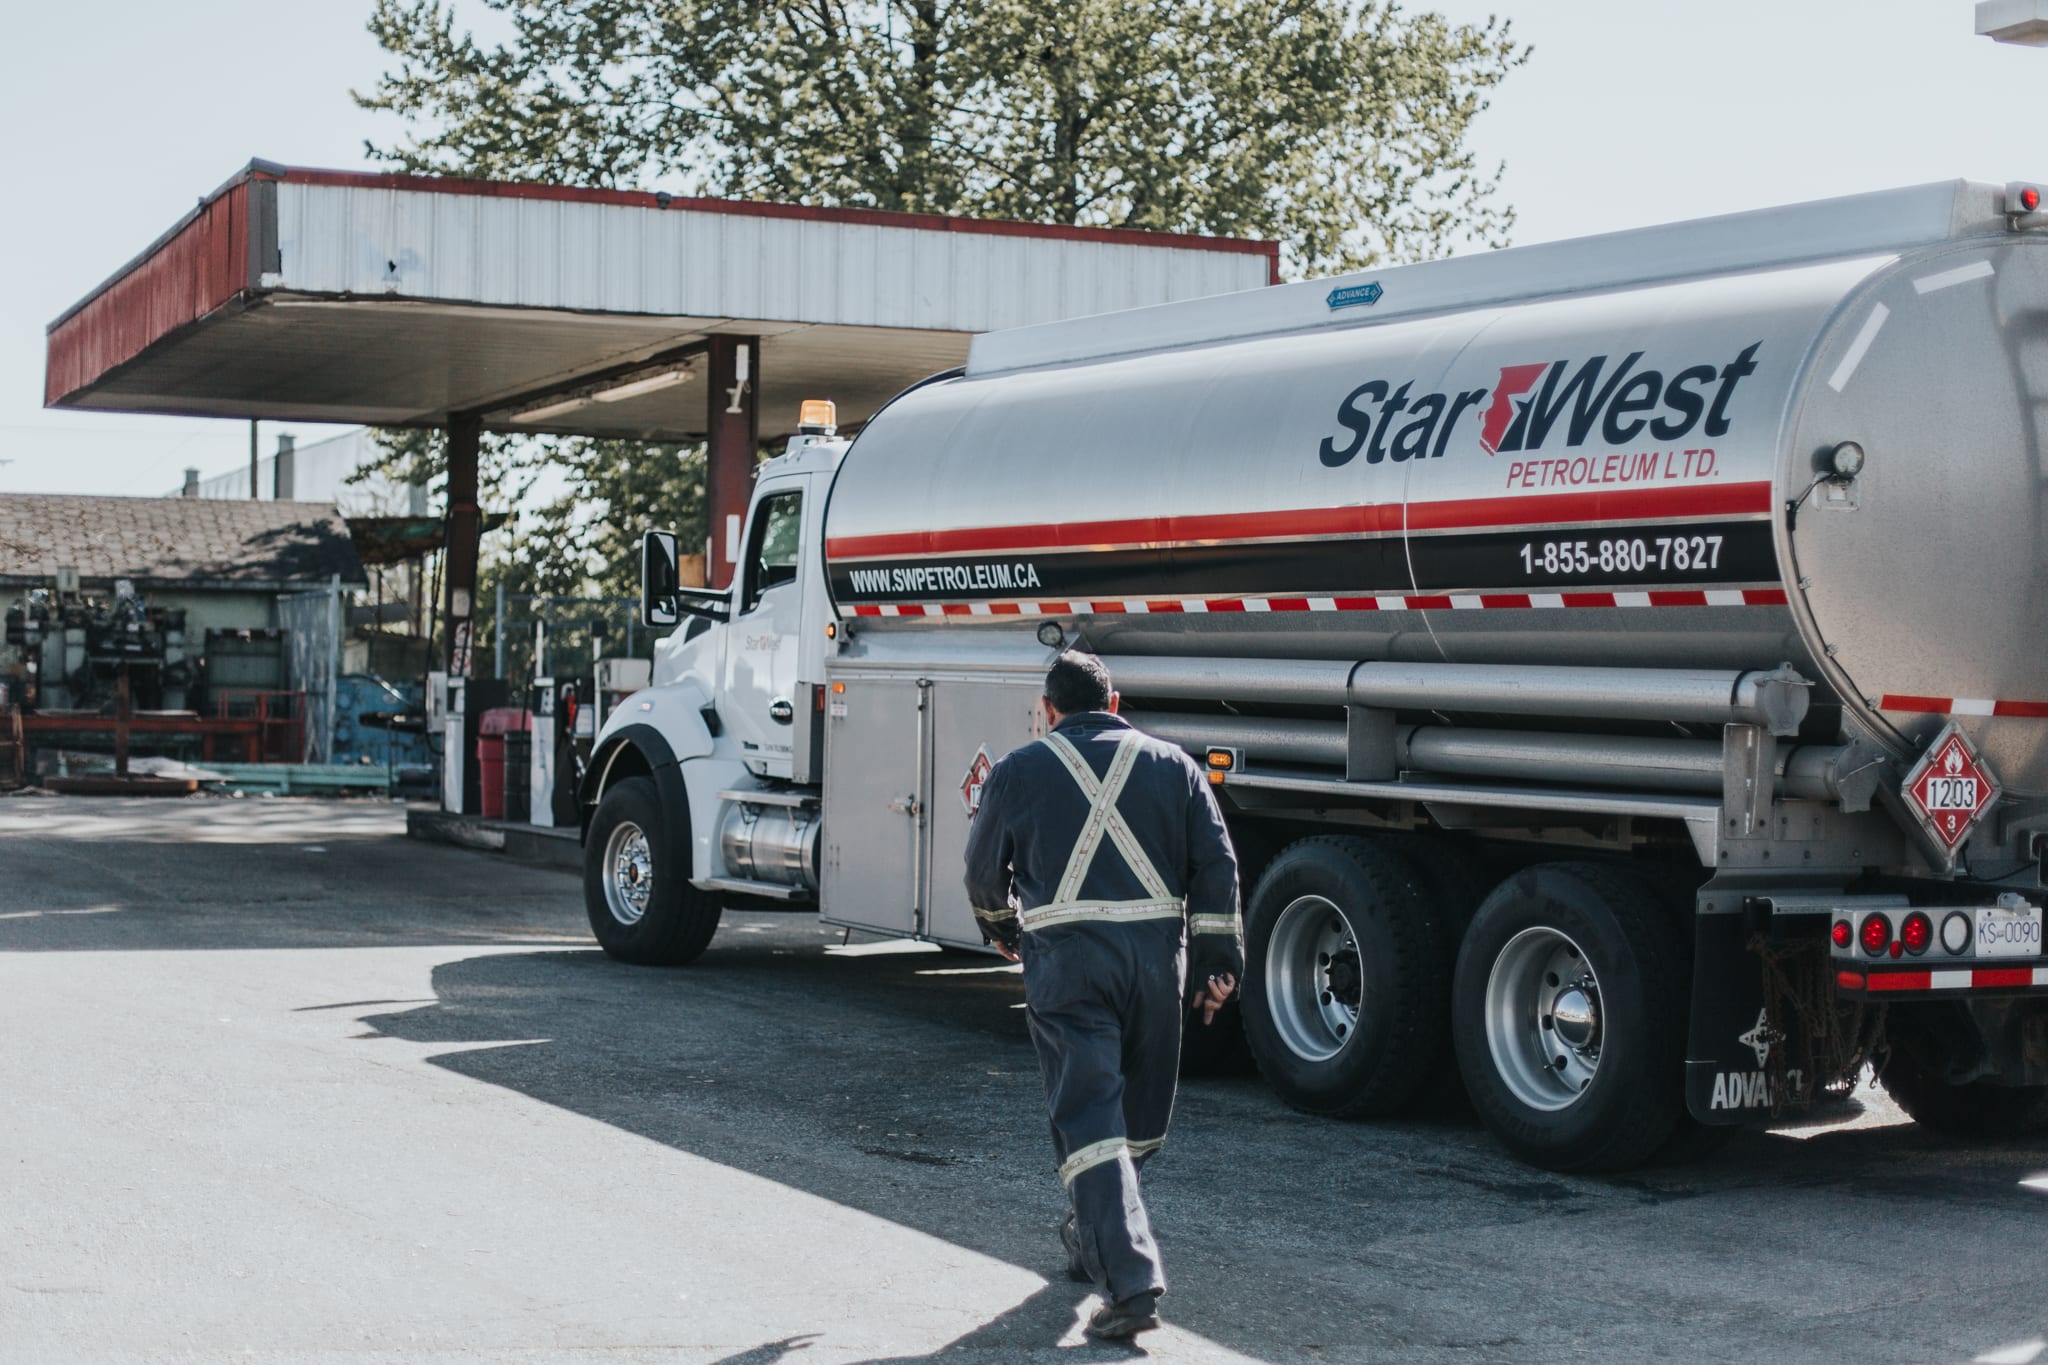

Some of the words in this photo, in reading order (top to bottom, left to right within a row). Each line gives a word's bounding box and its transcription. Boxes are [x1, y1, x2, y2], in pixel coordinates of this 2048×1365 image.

[1336, 287, 1370, 300] ADVANCE
[1319, 378, 1488, 468] Star
[1525, 339, 1763, 451] West
[1506, 452, 1659, 488] PETROLEUM
[1664, 448, 1719, 479] LTD.
[1520, 535, 1723, 575] 1-855-880-7827
[849, 562, 1041, 594] WWW.SWPETROLEUM.CA
[1931, 780, 1974, 808] 1203
[1947, 815, 1956, 829] 3
